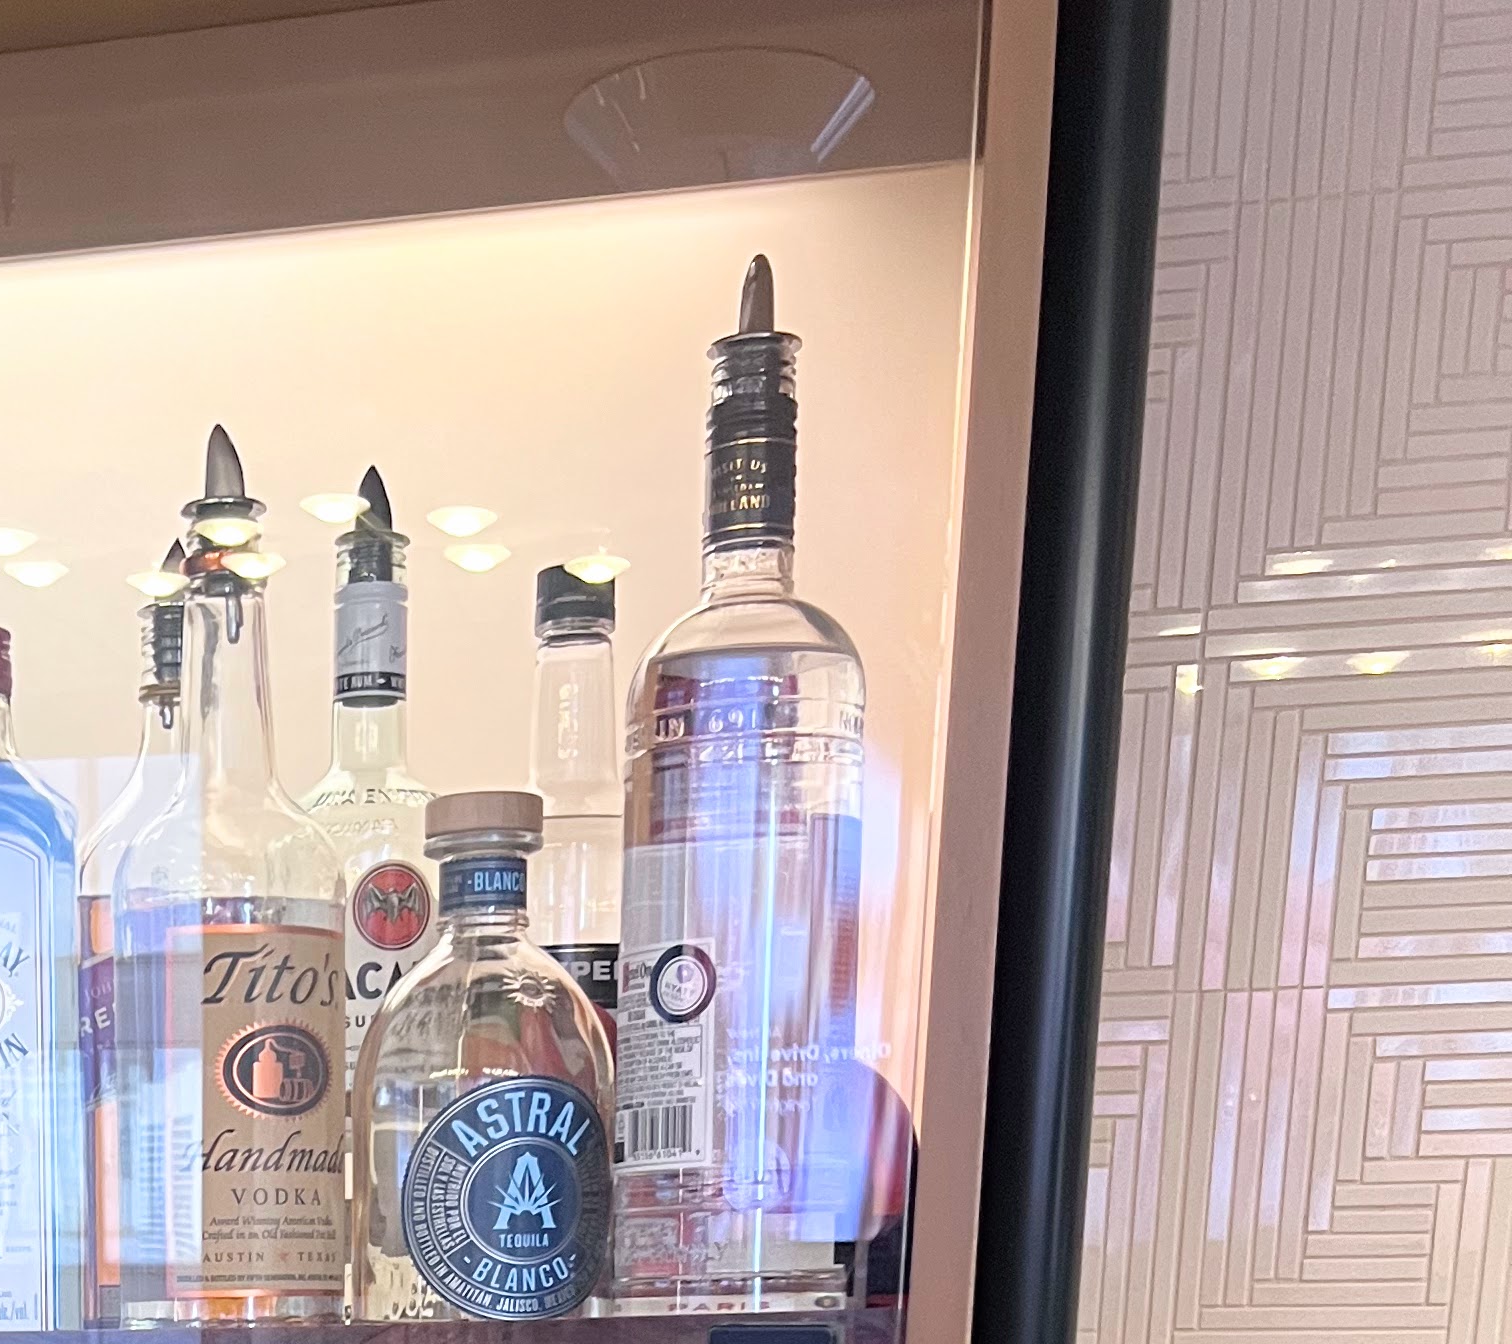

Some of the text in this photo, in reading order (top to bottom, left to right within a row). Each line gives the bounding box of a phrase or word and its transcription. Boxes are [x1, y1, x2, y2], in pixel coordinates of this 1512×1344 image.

[201, 943, 339, 1008] Tito's
[451, 1090, 591, 1157] ASTRAL
[179, 1129, 344, 1174] Handmad
[231, 1188, 321, 1205] VODKA
[202, 1252, 265, 1263] AUSTIN
[498, 1233, 549, 1249] TEQUILA
[472, 1257, 569, 1292] BLANCO
